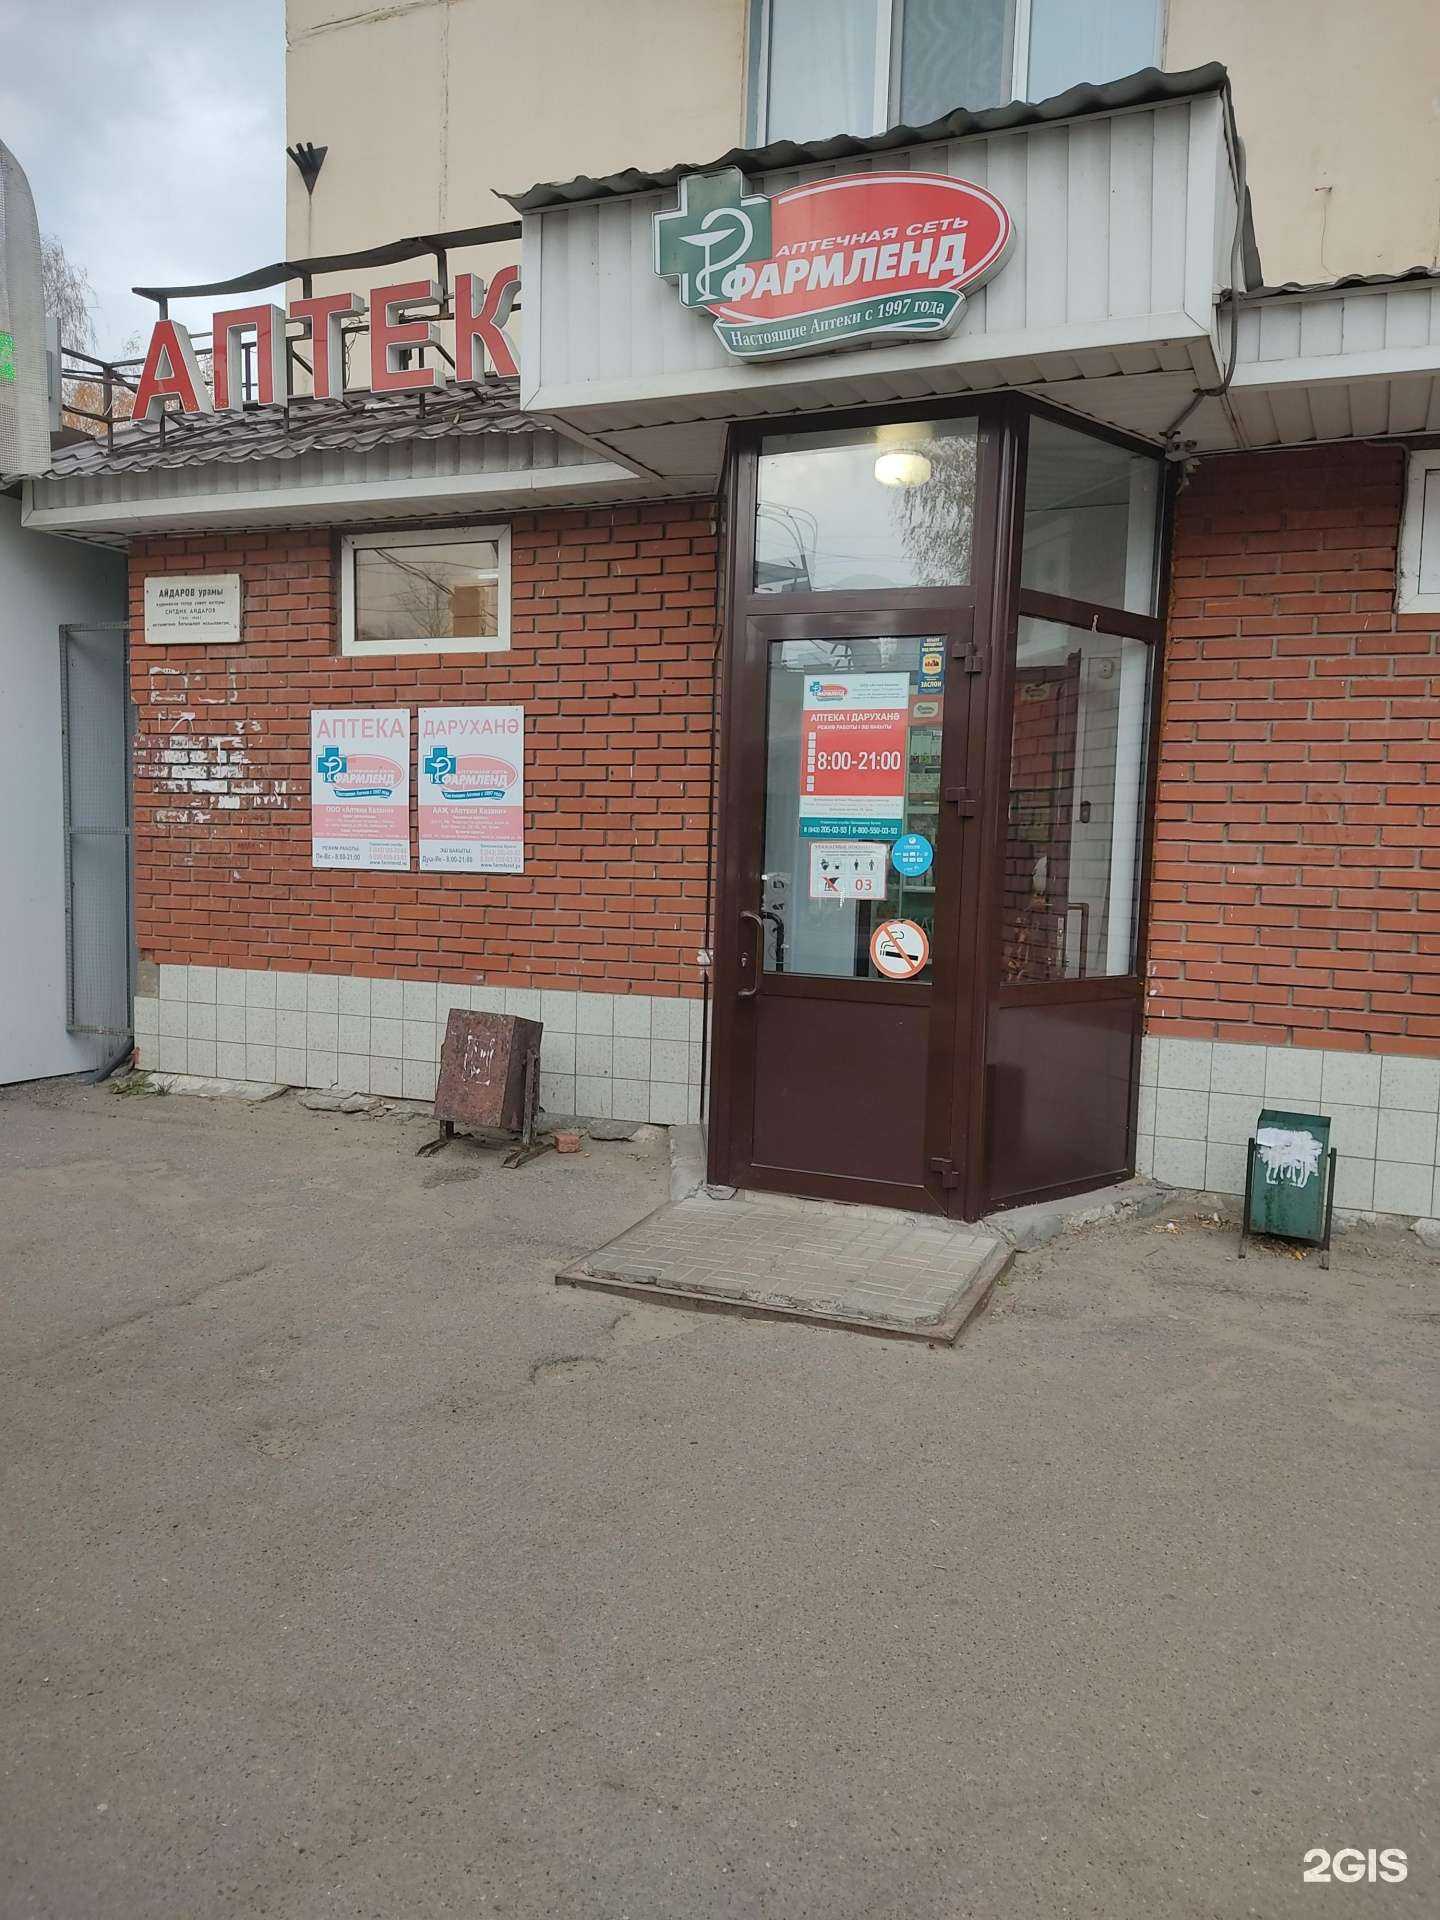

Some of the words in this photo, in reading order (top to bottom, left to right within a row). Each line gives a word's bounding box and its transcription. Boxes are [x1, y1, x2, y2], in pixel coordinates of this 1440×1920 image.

[775, 226, 899, 258] АПТЕЧНАЯ
[905, 216, 969, 236] СЕТЬ
[720, 233, 967, 301] ФАРМЛЕНД
[730, 322, 807, 347] Настоящие
[810, 311, 862, 335] Аптеки
[865, 310, 874, 320] с
[877, 298, 912, 318] 1997
[914, 299, 945, 316] года
[131, 265, 521, 421] АПТЕК
[159, 587, 195, 599] АЙДАРОВ
[198, 588, 224, 598] урамы
[810, 713, 846, 722] АПТЕКА
[851, 712, 900, 722] ДАРУХАНӘ
[317, 718, 405, 738] АПТЕКА
[424, 718, 519, 738] ДАРУХАНӘ
[817, 751, 901, 770] 8:00-21:00
[442, 773, 508, 787] ФАРМЛЕНД
[855, 879, 872, 891] 03
